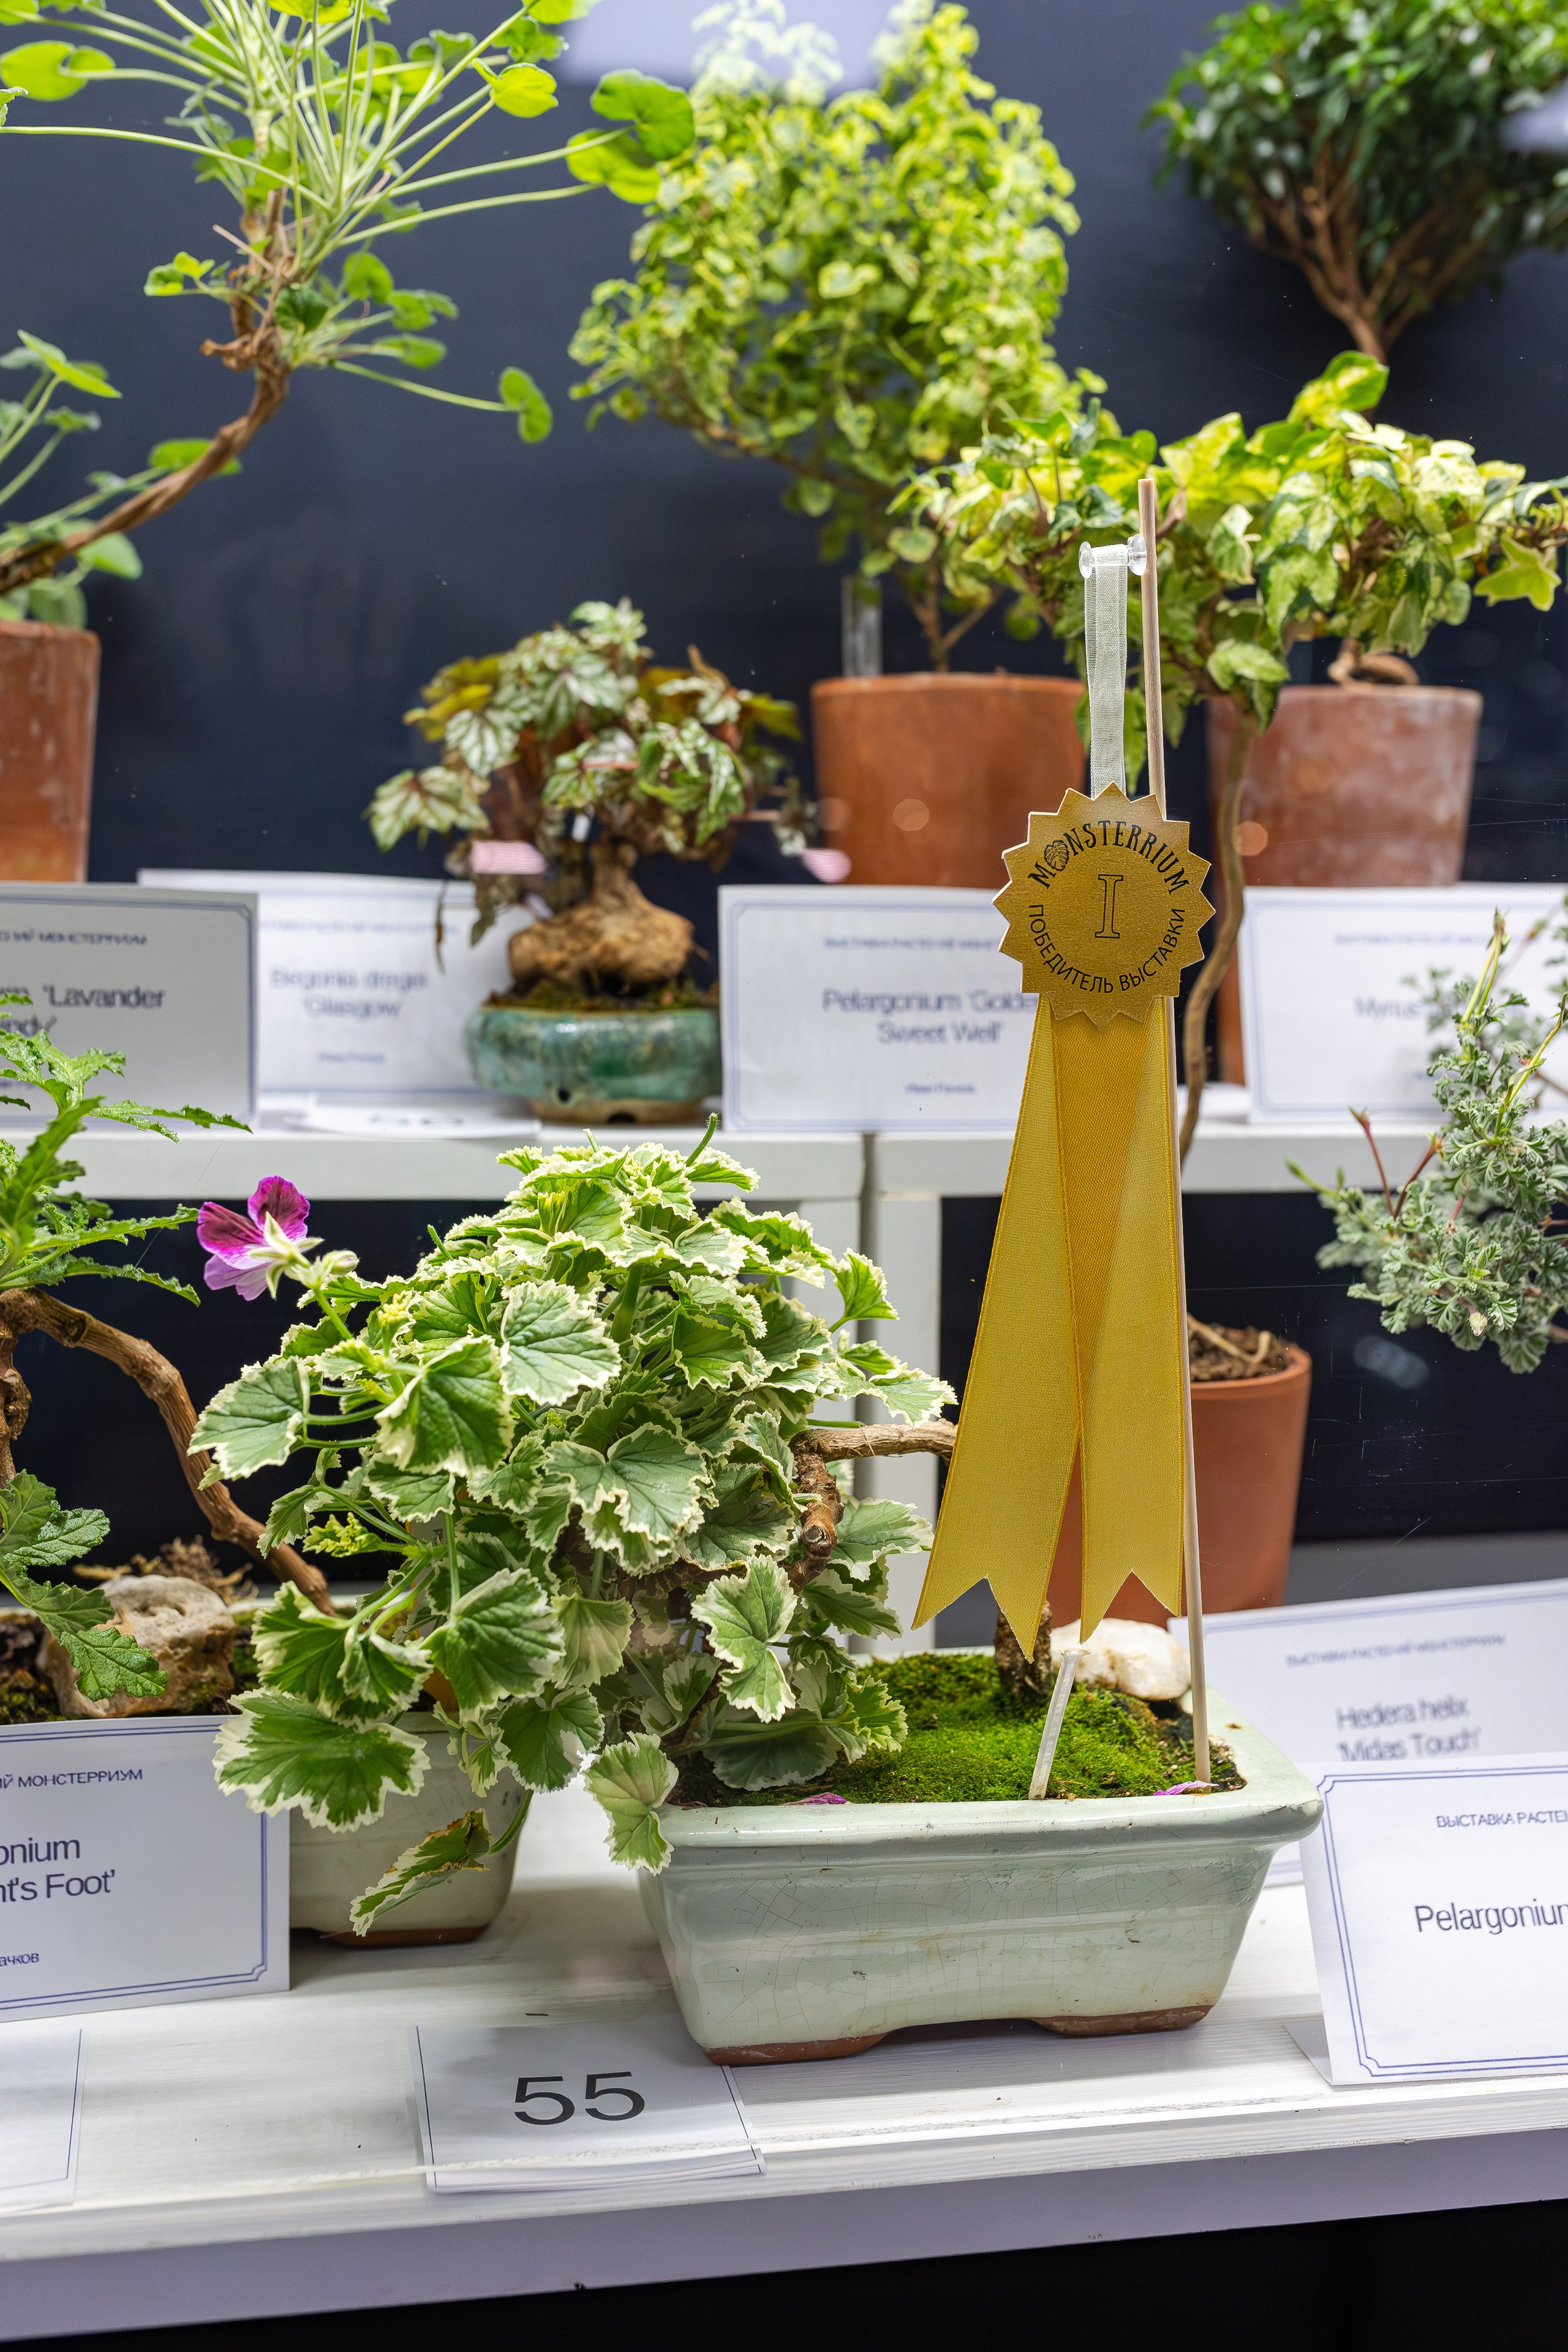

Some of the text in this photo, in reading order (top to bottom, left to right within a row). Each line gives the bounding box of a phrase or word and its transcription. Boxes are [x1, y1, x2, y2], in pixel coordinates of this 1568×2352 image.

[1095, 874, 1124, 939] I
[1028, 904, 1186, 993] ПОБЕДИТЕЛЬ ВЫСТАВКИ
[823, 987, 962, 1017] Pelargonium
[876, 1020, 946, 1044] Sweet
[1335, 1701, 1417, 1731] Hedera
[18, 1769, 143, 1787] МОНСТЕРРИУМ
[1436, 1812, 1515, 1828] ВЫСТАВКА
[46, 1869, 115, 1899] Foot'
[514, 2071, 646, 2125] 55
